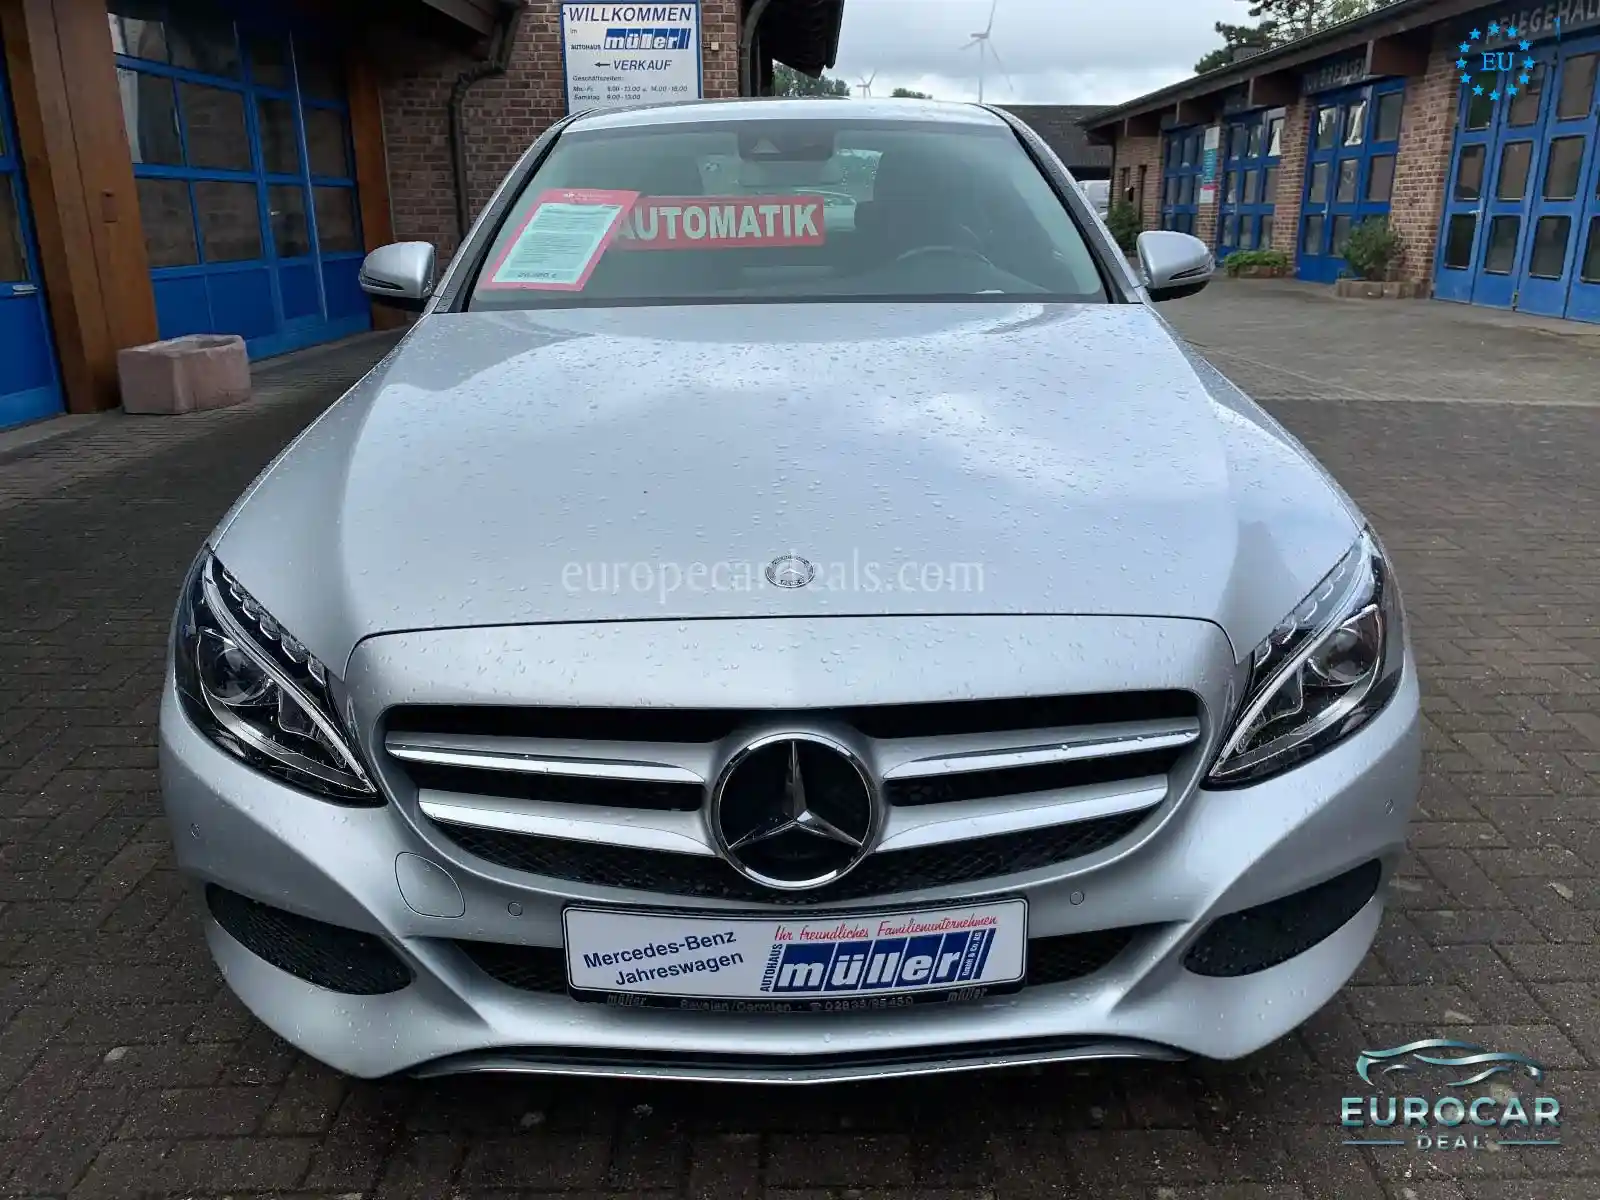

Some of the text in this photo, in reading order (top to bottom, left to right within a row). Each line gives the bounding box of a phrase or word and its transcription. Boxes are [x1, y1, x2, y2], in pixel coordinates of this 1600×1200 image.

[569, 7, 692, 22] WILLKOMMEN
[604, 33, 679, 49] müller
[613, 59, 673, 71] VERKAUF
[617, 203, 819, 241] AUTOMATIK
[774, 913, 998, 941] Ihr freundliches Familienunternehmen
[583, 931, 737, 968] Mercedes-Benz
[615, 952, 744, 986] Jahreswagen
[760, 943, 784, 992] AUTOHAUS
[777, 951, 962, 988] müller
[606, 993, 647, 1007] müller
[948, 987, 988, 1002] müller
